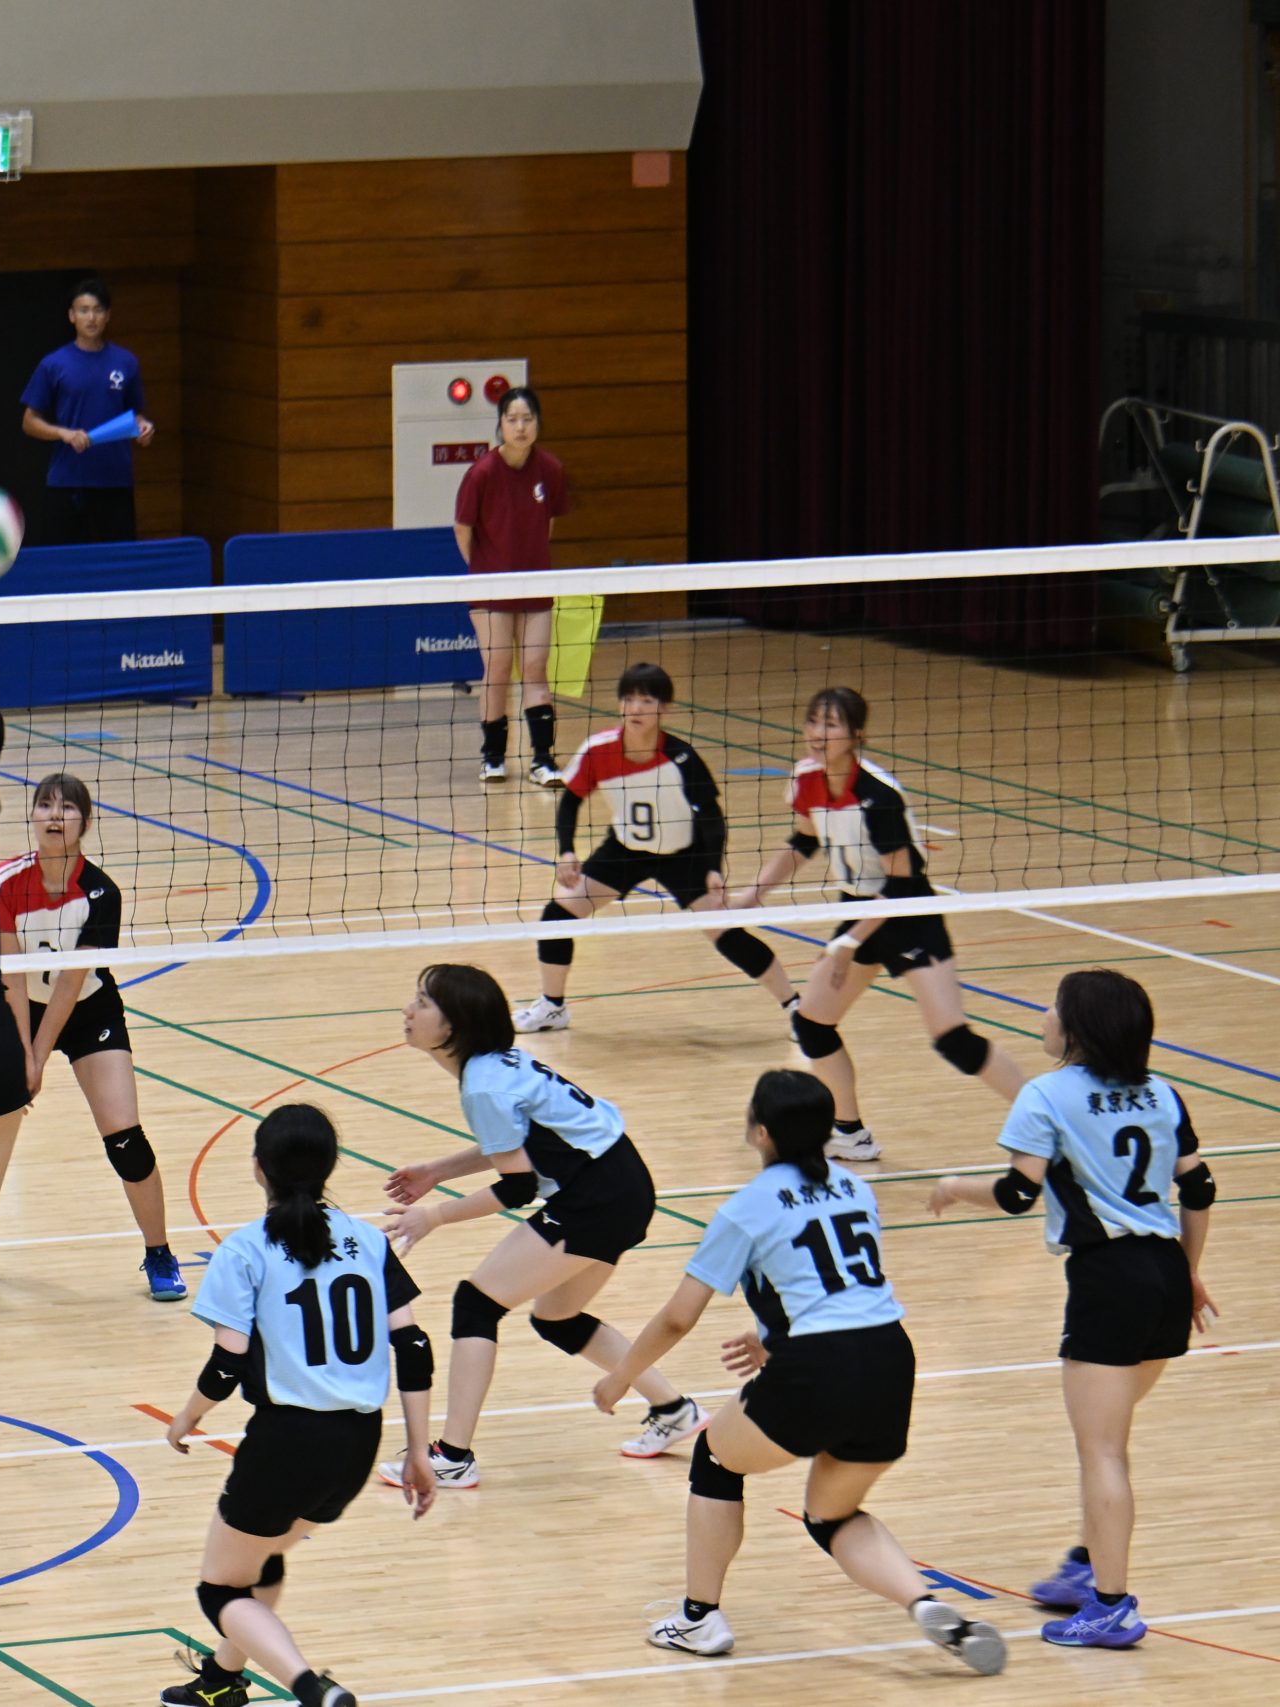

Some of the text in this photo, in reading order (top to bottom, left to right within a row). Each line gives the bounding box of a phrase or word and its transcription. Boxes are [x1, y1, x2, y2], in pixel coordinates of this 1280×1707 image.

[121, 650, 185, 672] Nittaku
[415, 633, 479, 654] Nittaku
[631, 802, 654, 842] 9
[1087, 1088, 1158, 1116] 東京大学
[1113, 1125, 1160, 1207] 2
[777, 1178, 855, 1210] 東京大学
[791, 1210, 886, 1296] 15
[284, 1273, 375, 1367] 10
